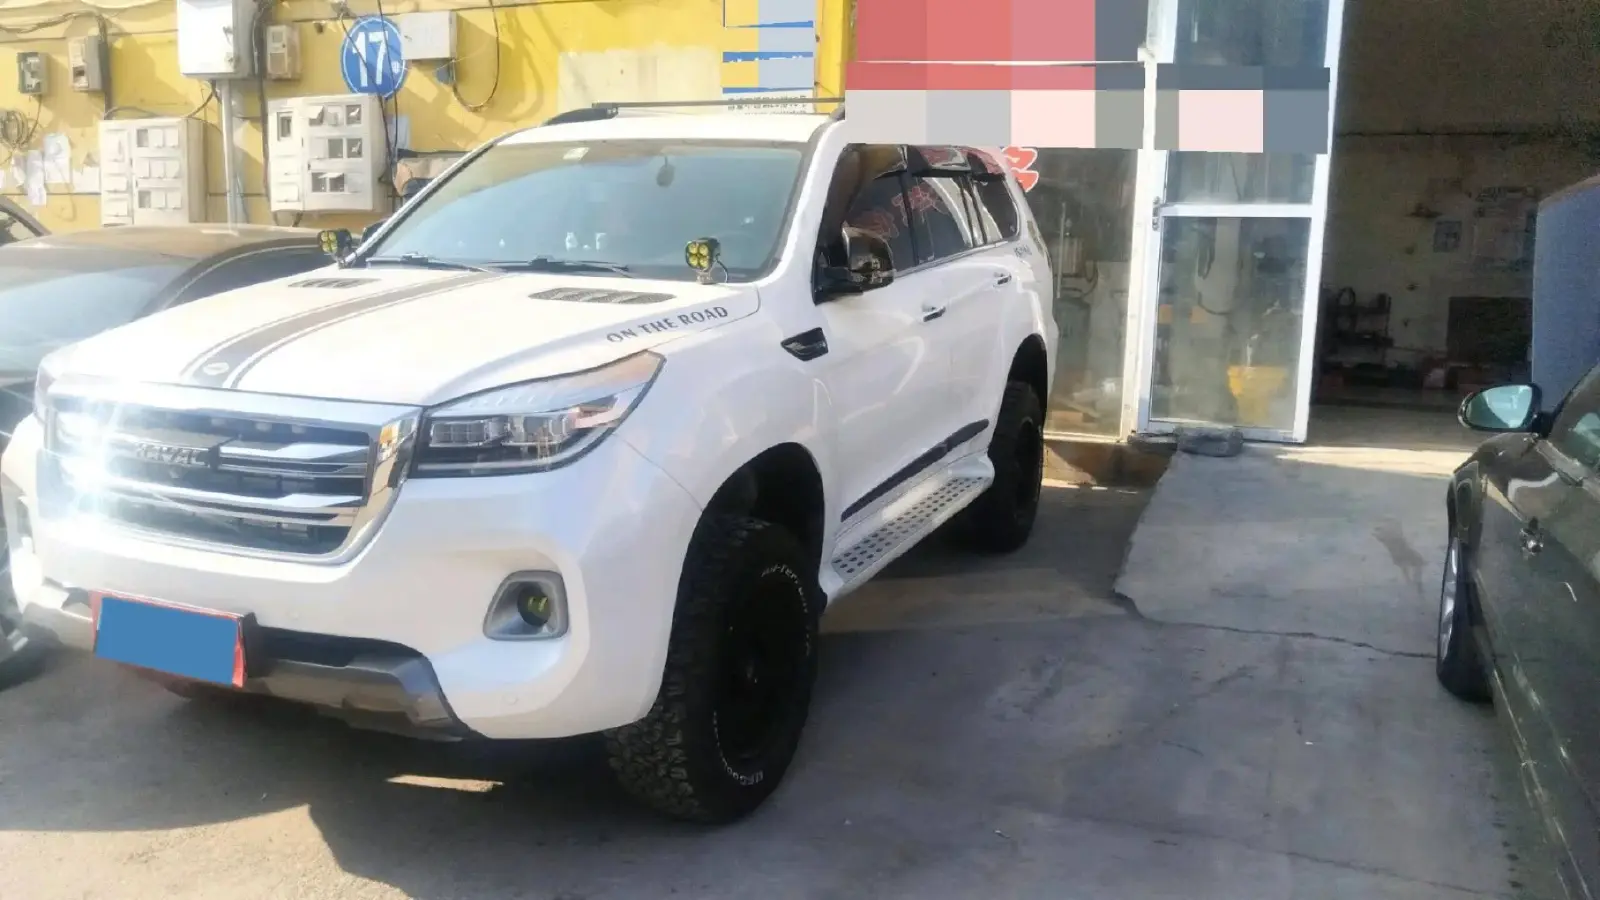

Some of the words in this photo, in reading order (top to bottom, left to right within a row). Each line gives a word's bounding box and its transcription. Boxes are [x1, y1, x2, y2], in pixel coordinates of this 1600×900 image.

[352, 31, 389, 88] 17
[606, 328, 638, 343] ON
[638, 318, 678, 335] THE
[677, 306, 728, 325] ROAD
